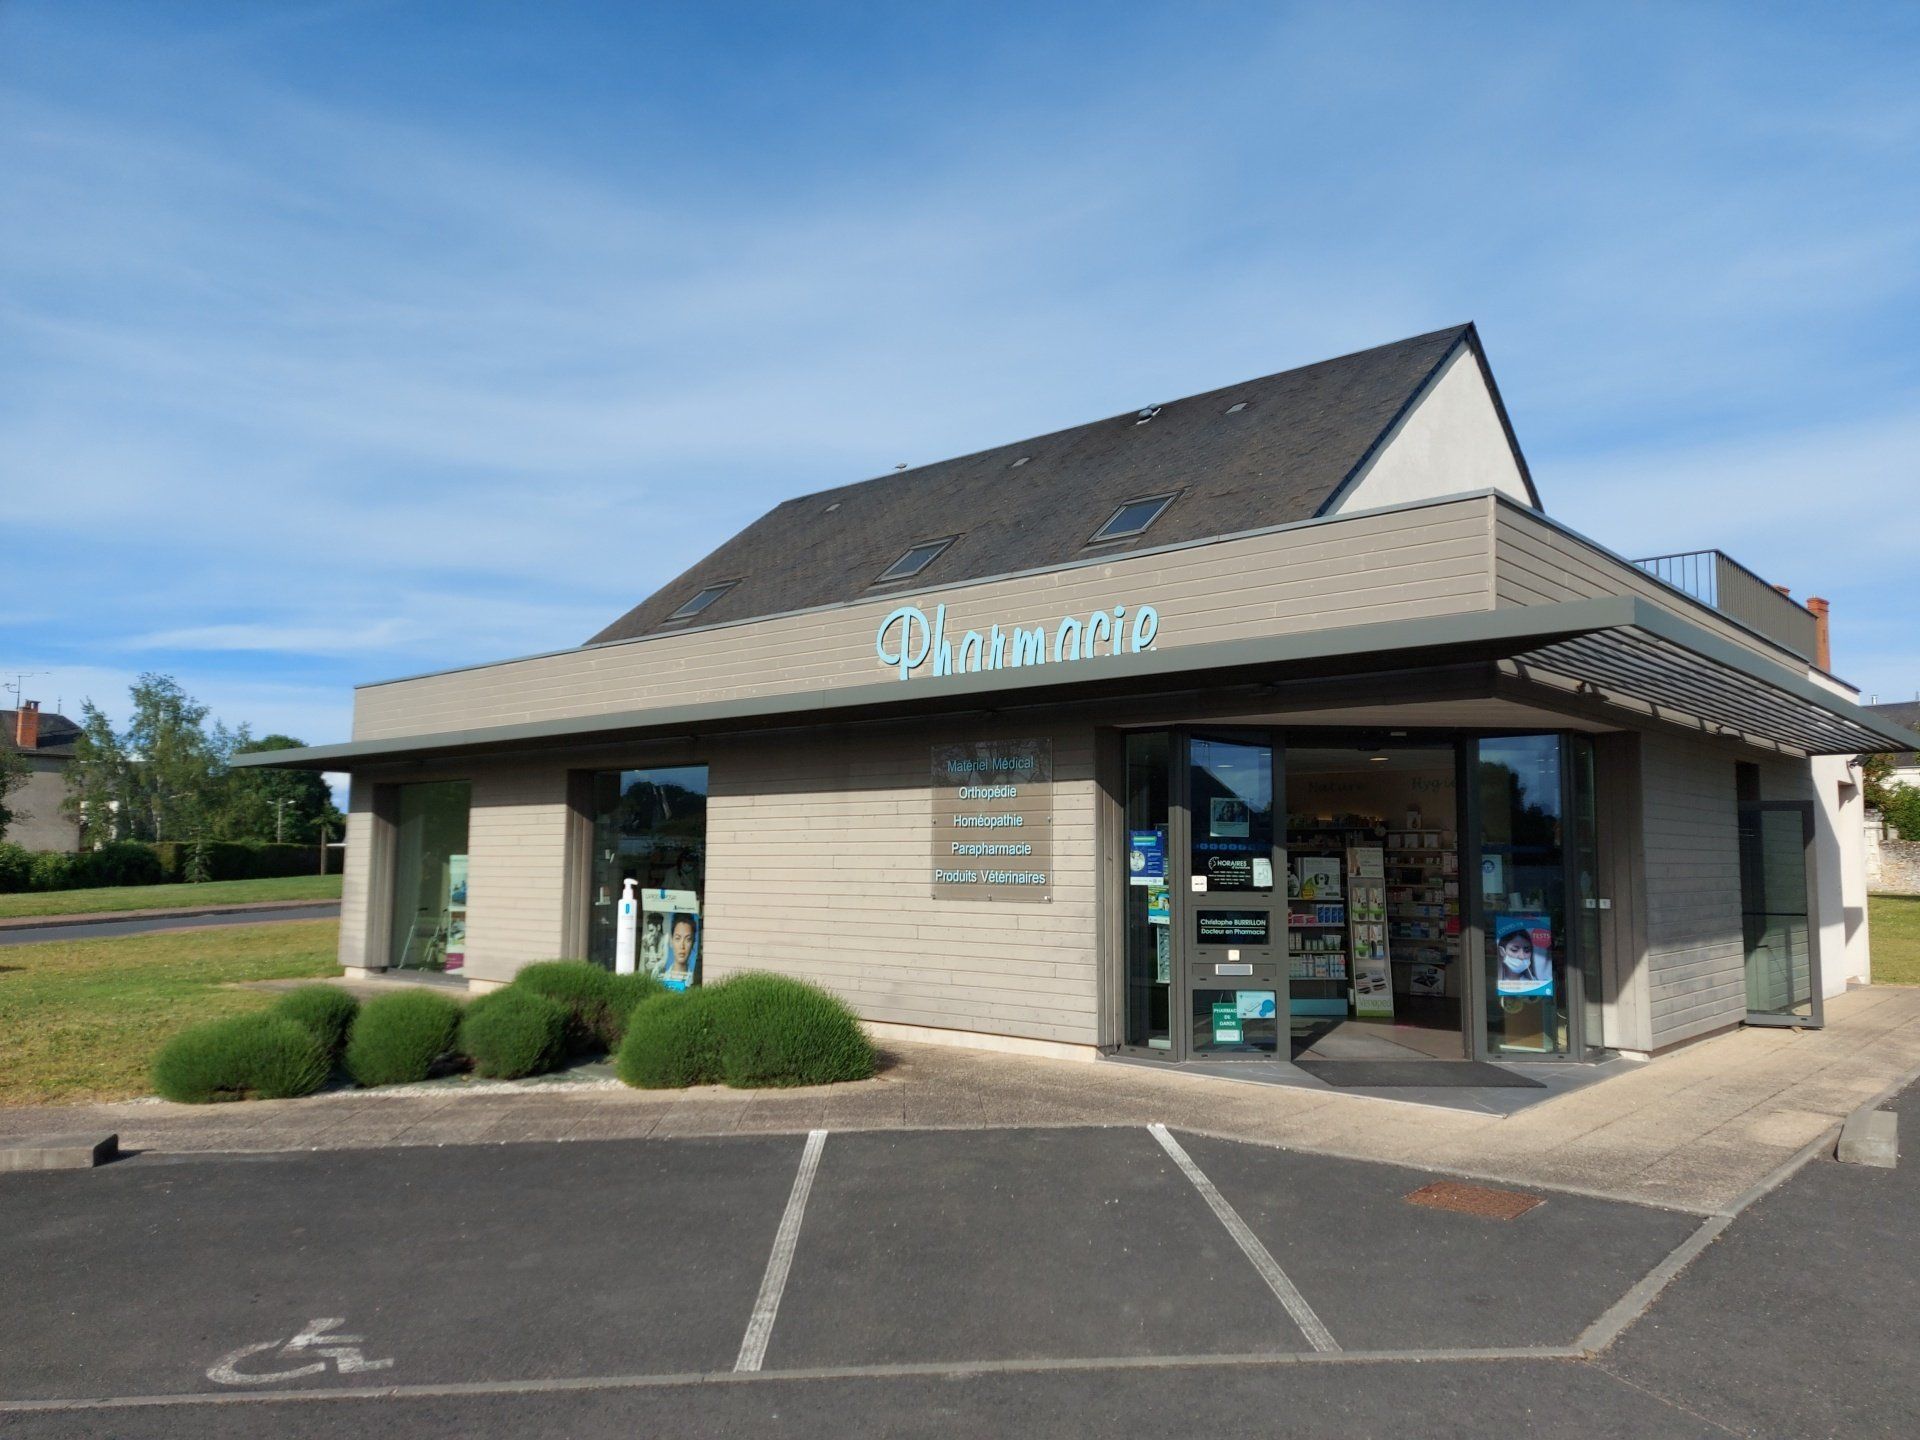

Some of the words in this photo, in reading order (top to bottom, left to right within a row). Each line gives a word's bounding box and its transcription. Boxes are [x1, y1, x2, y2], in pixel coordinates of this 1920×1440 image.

[876, 603, 1159, 682] Pharmacie
[947, 758, 988, 773] Matériel
[992, 755, 1034, 771] Médical
[959, 785, 1017, 801] Orthopédie
[953, 813, 1023, 829] Homéopathie
[951, 841, 1032, 858] Parapharmacie
[935, 869, 978, 883] Produits
[980, 869, 1046, 885] Vétérinaires
[1200, 919, 1233, 927] Christophe
